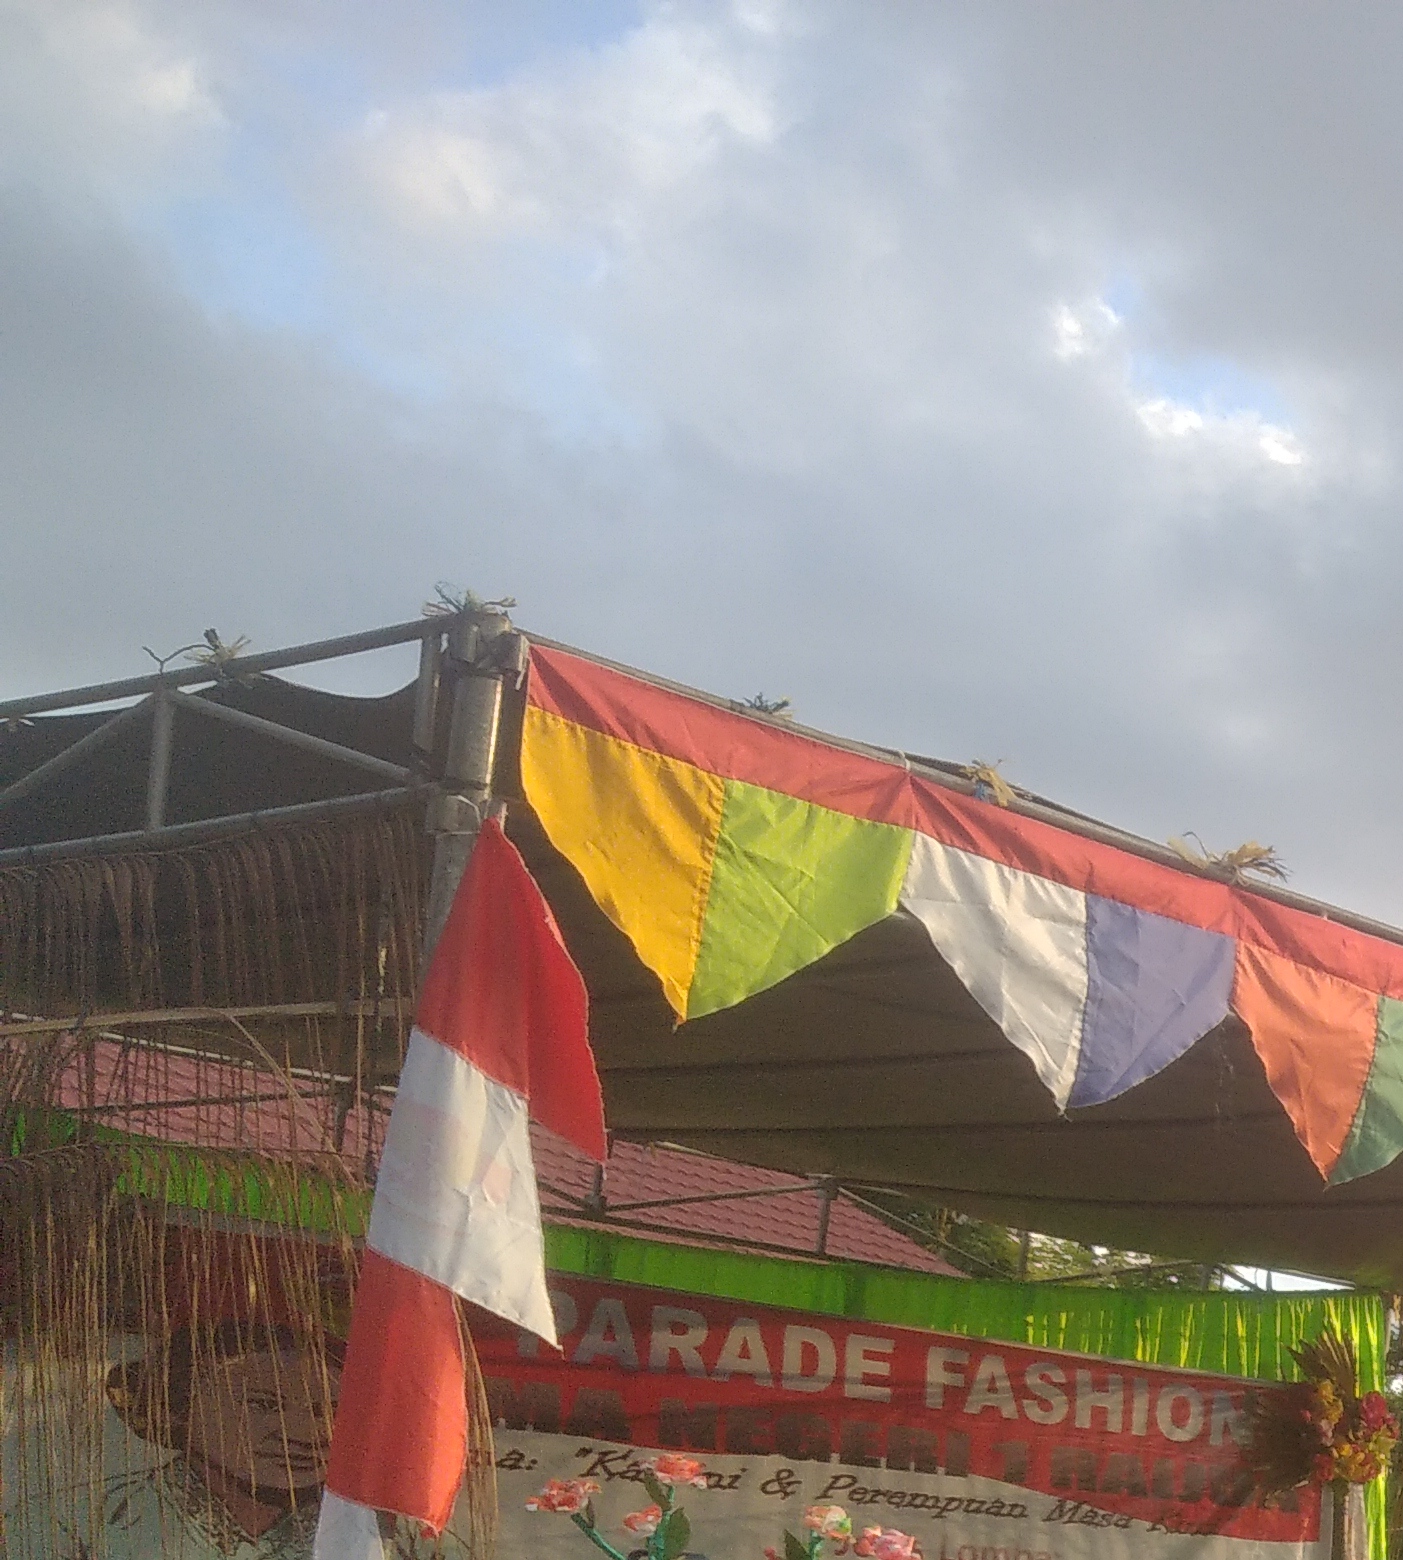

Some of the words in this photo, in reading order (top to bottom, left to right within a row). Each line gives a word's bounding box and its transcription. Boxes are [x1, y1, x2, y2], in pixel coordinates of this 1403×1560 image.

[516, 1289, 897, 1403] PARADE
[924, 1346, 1262, 1449] FASHION
[761, 1468, 803, 1499] &
[815, 1473, 1029, 1519] Perempuan
[1042, 1499, 1132, 1529] Masa
